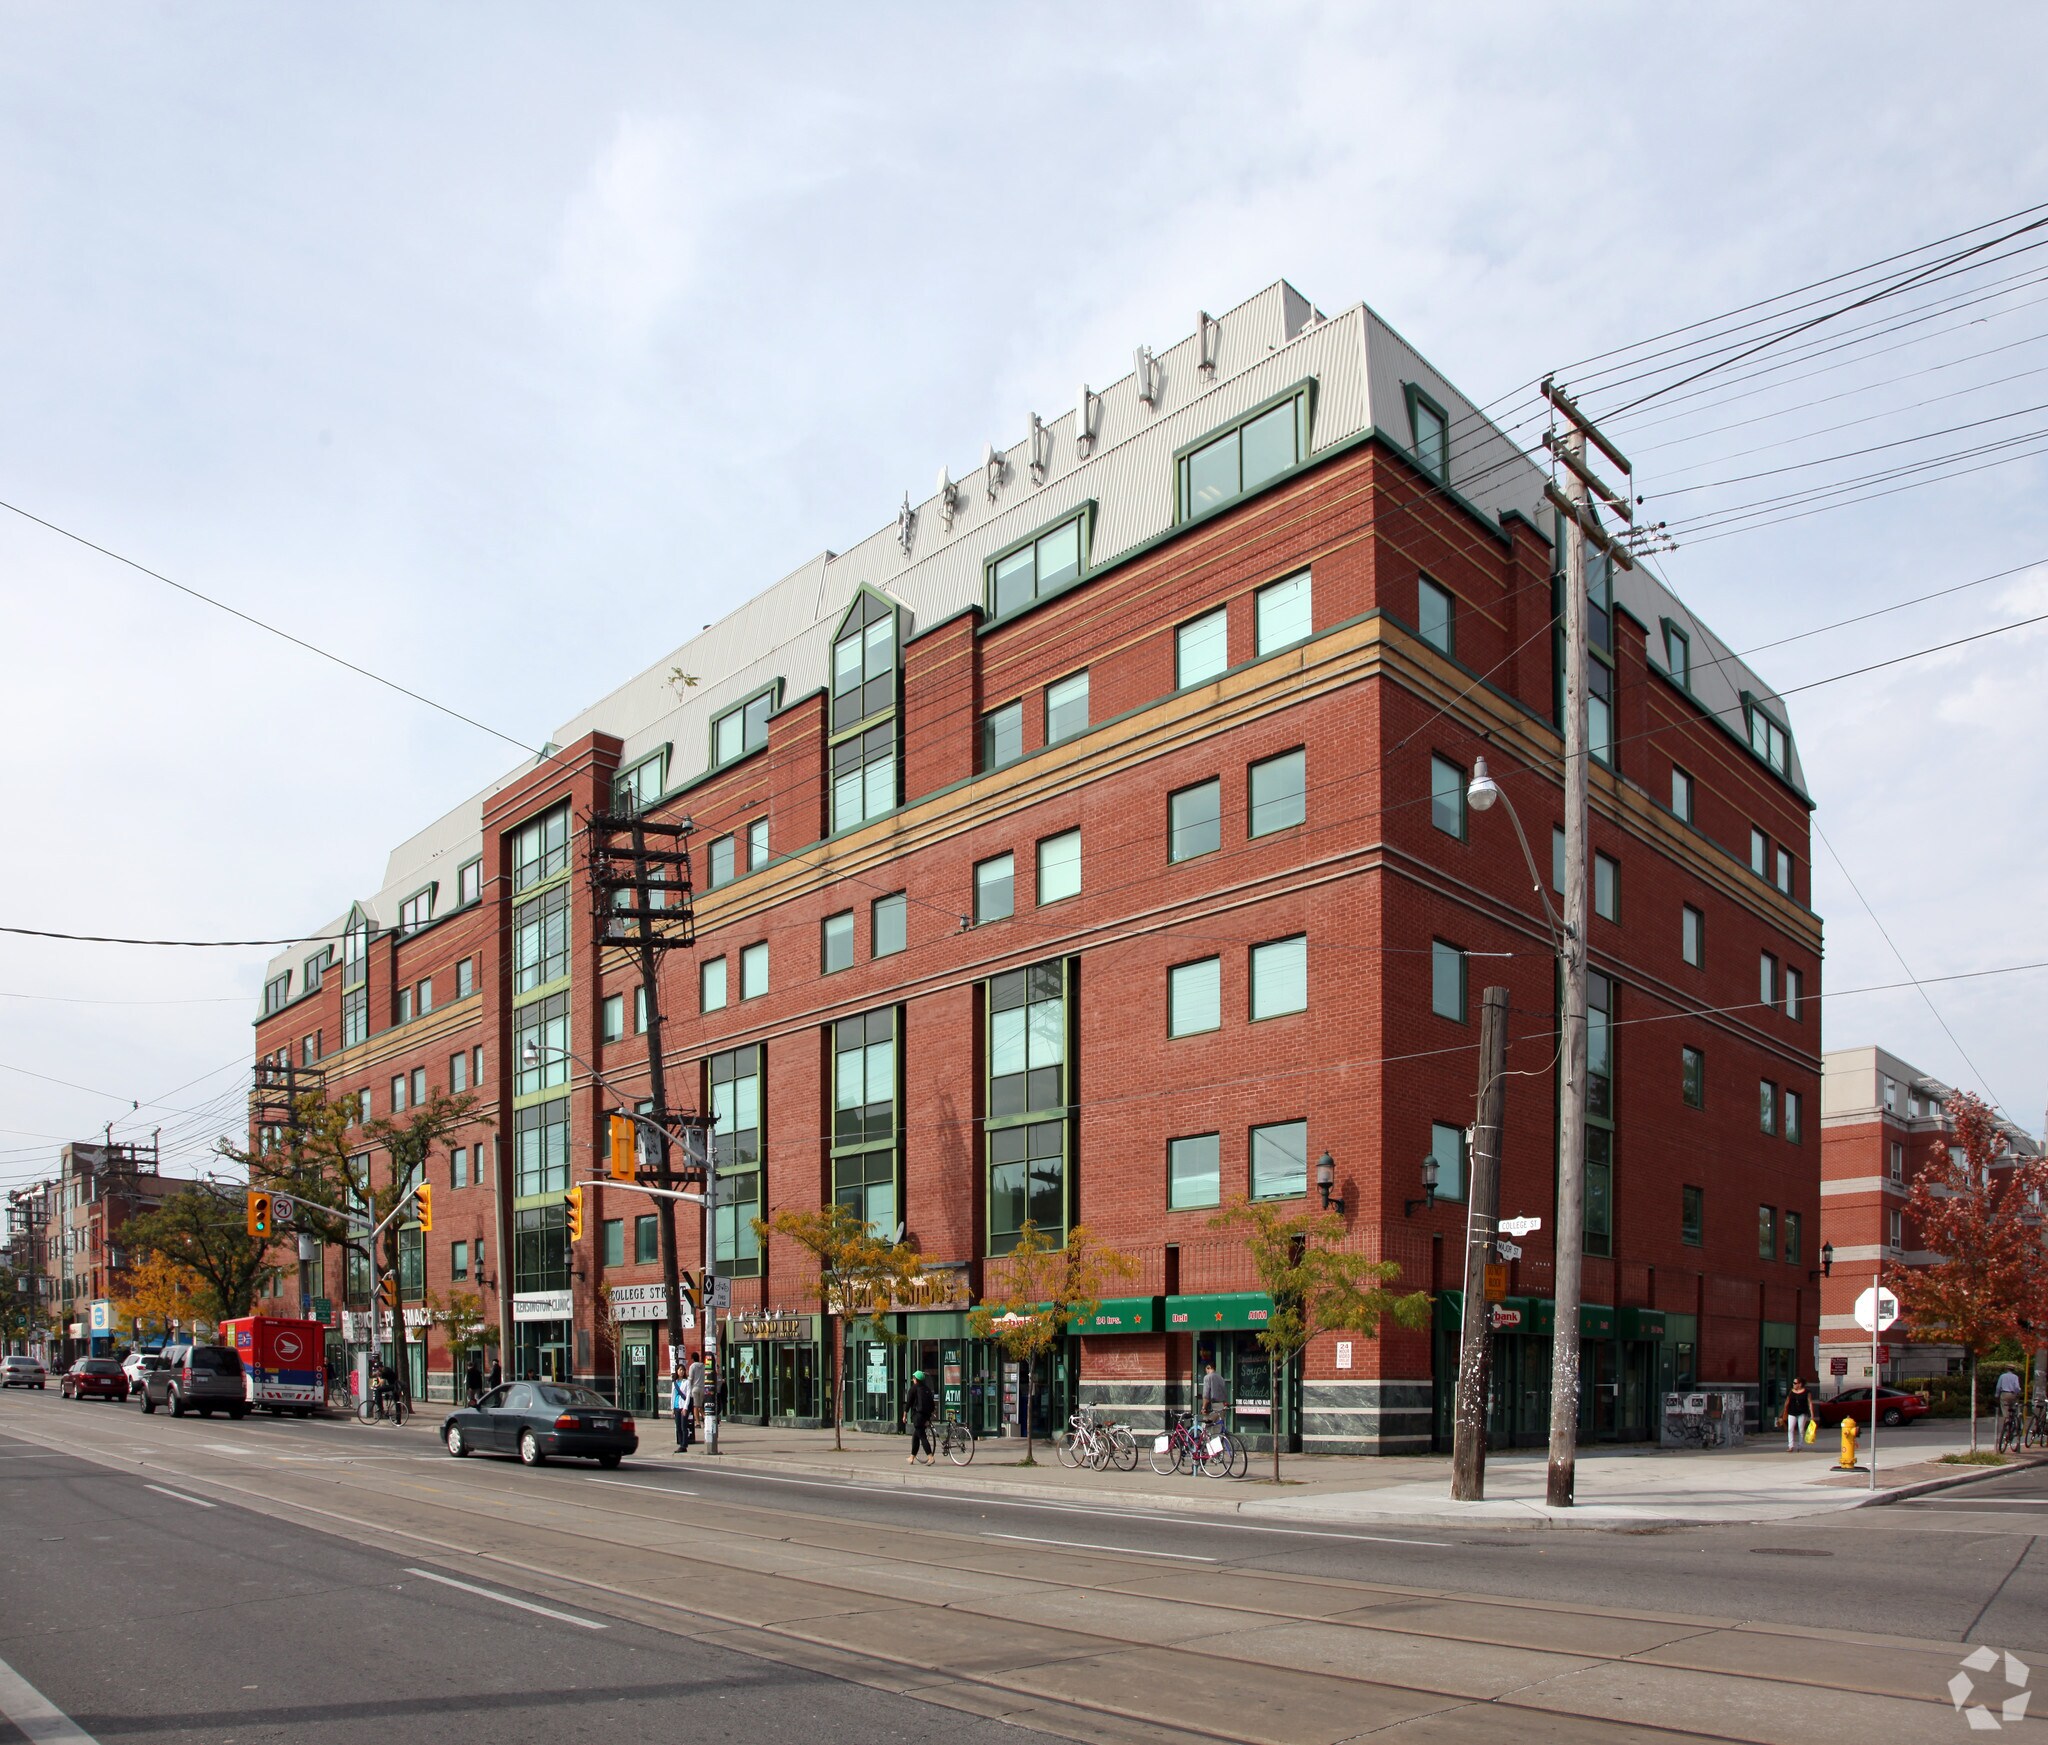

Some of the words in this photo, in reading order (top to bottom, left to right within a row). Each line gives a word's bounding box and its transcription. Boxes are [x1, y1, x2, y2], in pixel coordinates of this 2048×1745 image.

[1502, 1220, 1527, 1230] COLLEGE
[1498, 1242, 1512, 1255] MAJOR
[610, 1287, 645, 1302] COLLEGE
[650, 1286, 687, 1299] STRT
[552, 1298, 570, 1312] CLINIC
[1096, 1316, 1106, 1325] 24
[1172, 1313, 1188, 1323] Deli
[1248, 1310, 1268, 1321] ATM
[780, 1320, 799, 1333] CUP
[945, 1350, 956, 1361] ATM
[1241, 1364, 1267, 1378] Soups
[945, 1390, 961, 1402] ATM
[1240, 1384, 1270, 1398] Salads
